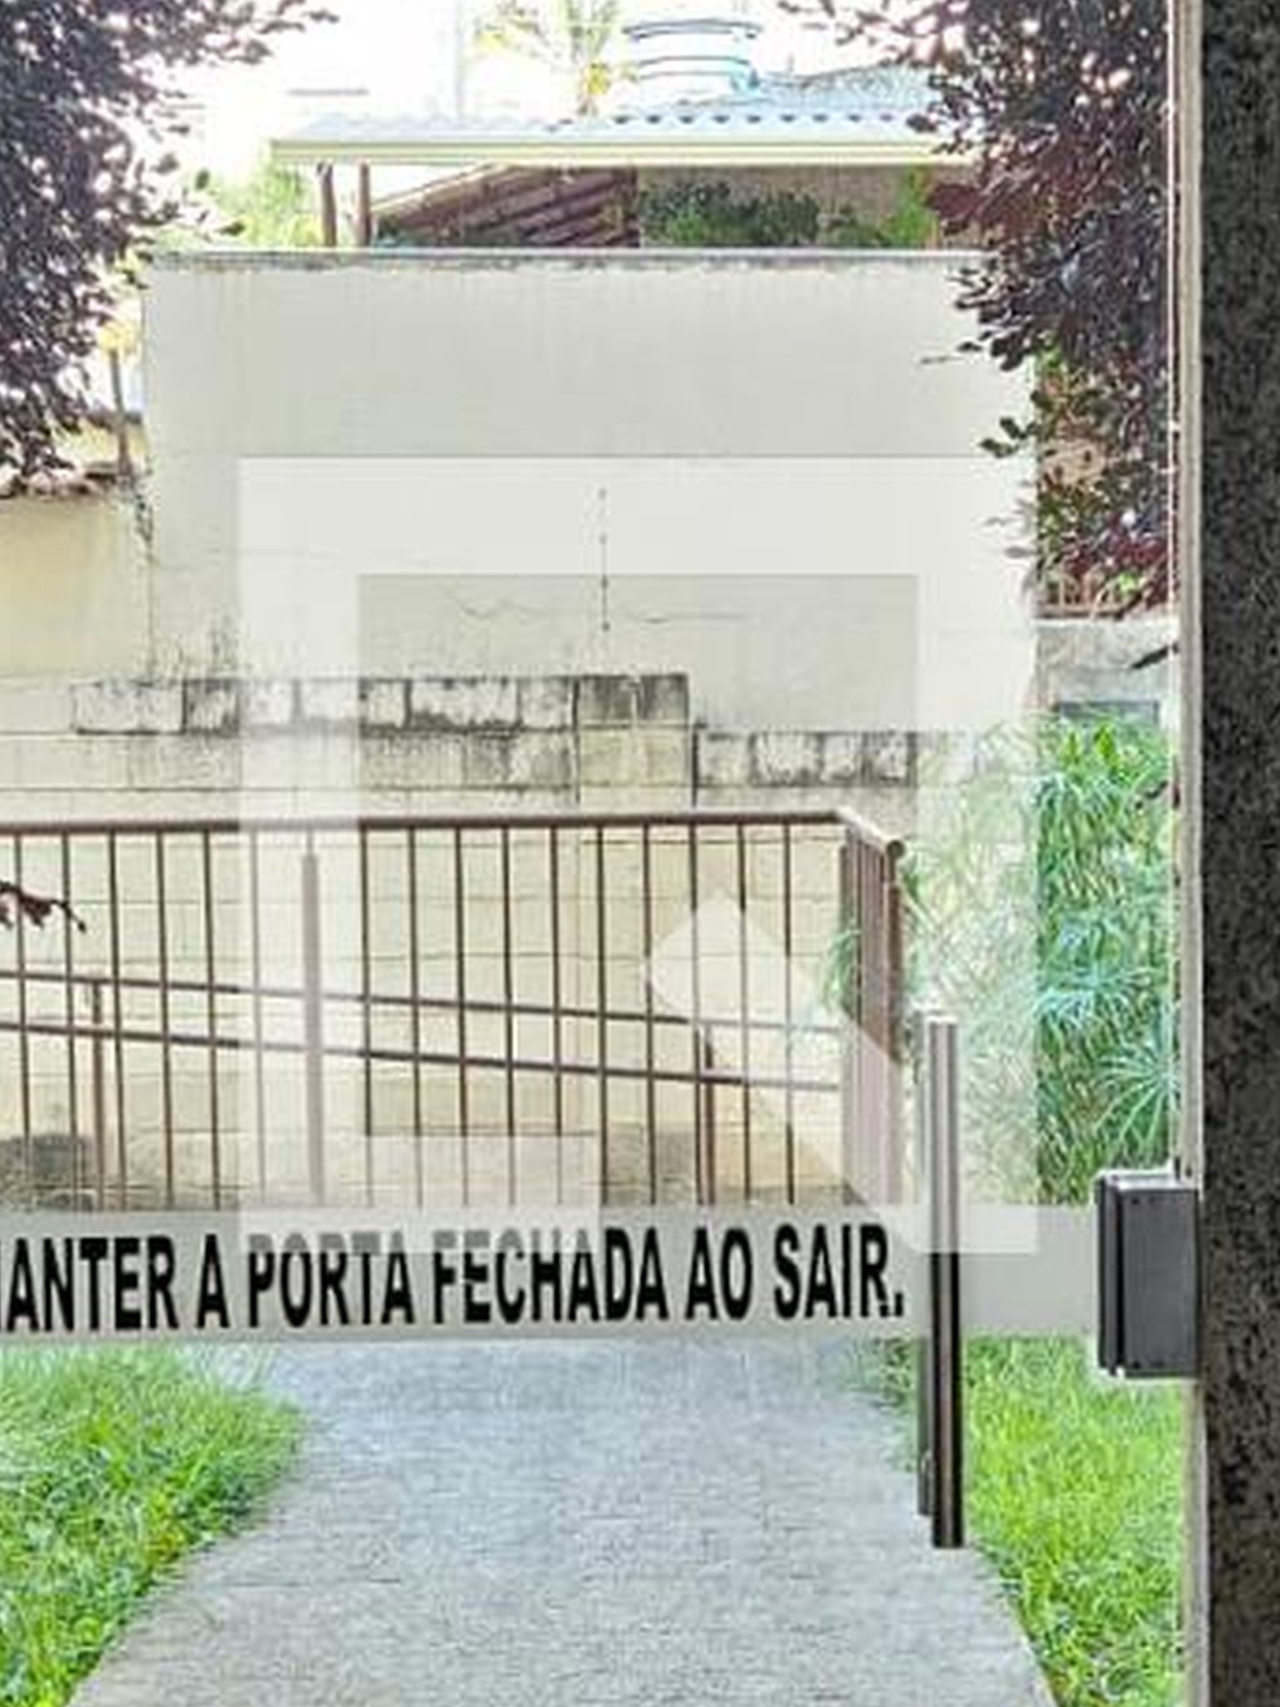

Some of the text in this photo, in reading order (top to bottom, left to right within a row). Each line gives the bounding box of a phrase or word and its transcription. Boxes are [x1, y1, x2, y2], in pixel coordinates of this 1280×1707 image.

[196, 1233, 231, 1329] A
[247, 1230, 416, 1328] PORTA
[432, 1226, 670, 1325] FECHADA
[685, 1225, 753, 1321] AO
[773, 1222, 905, 1319] SAIR.
